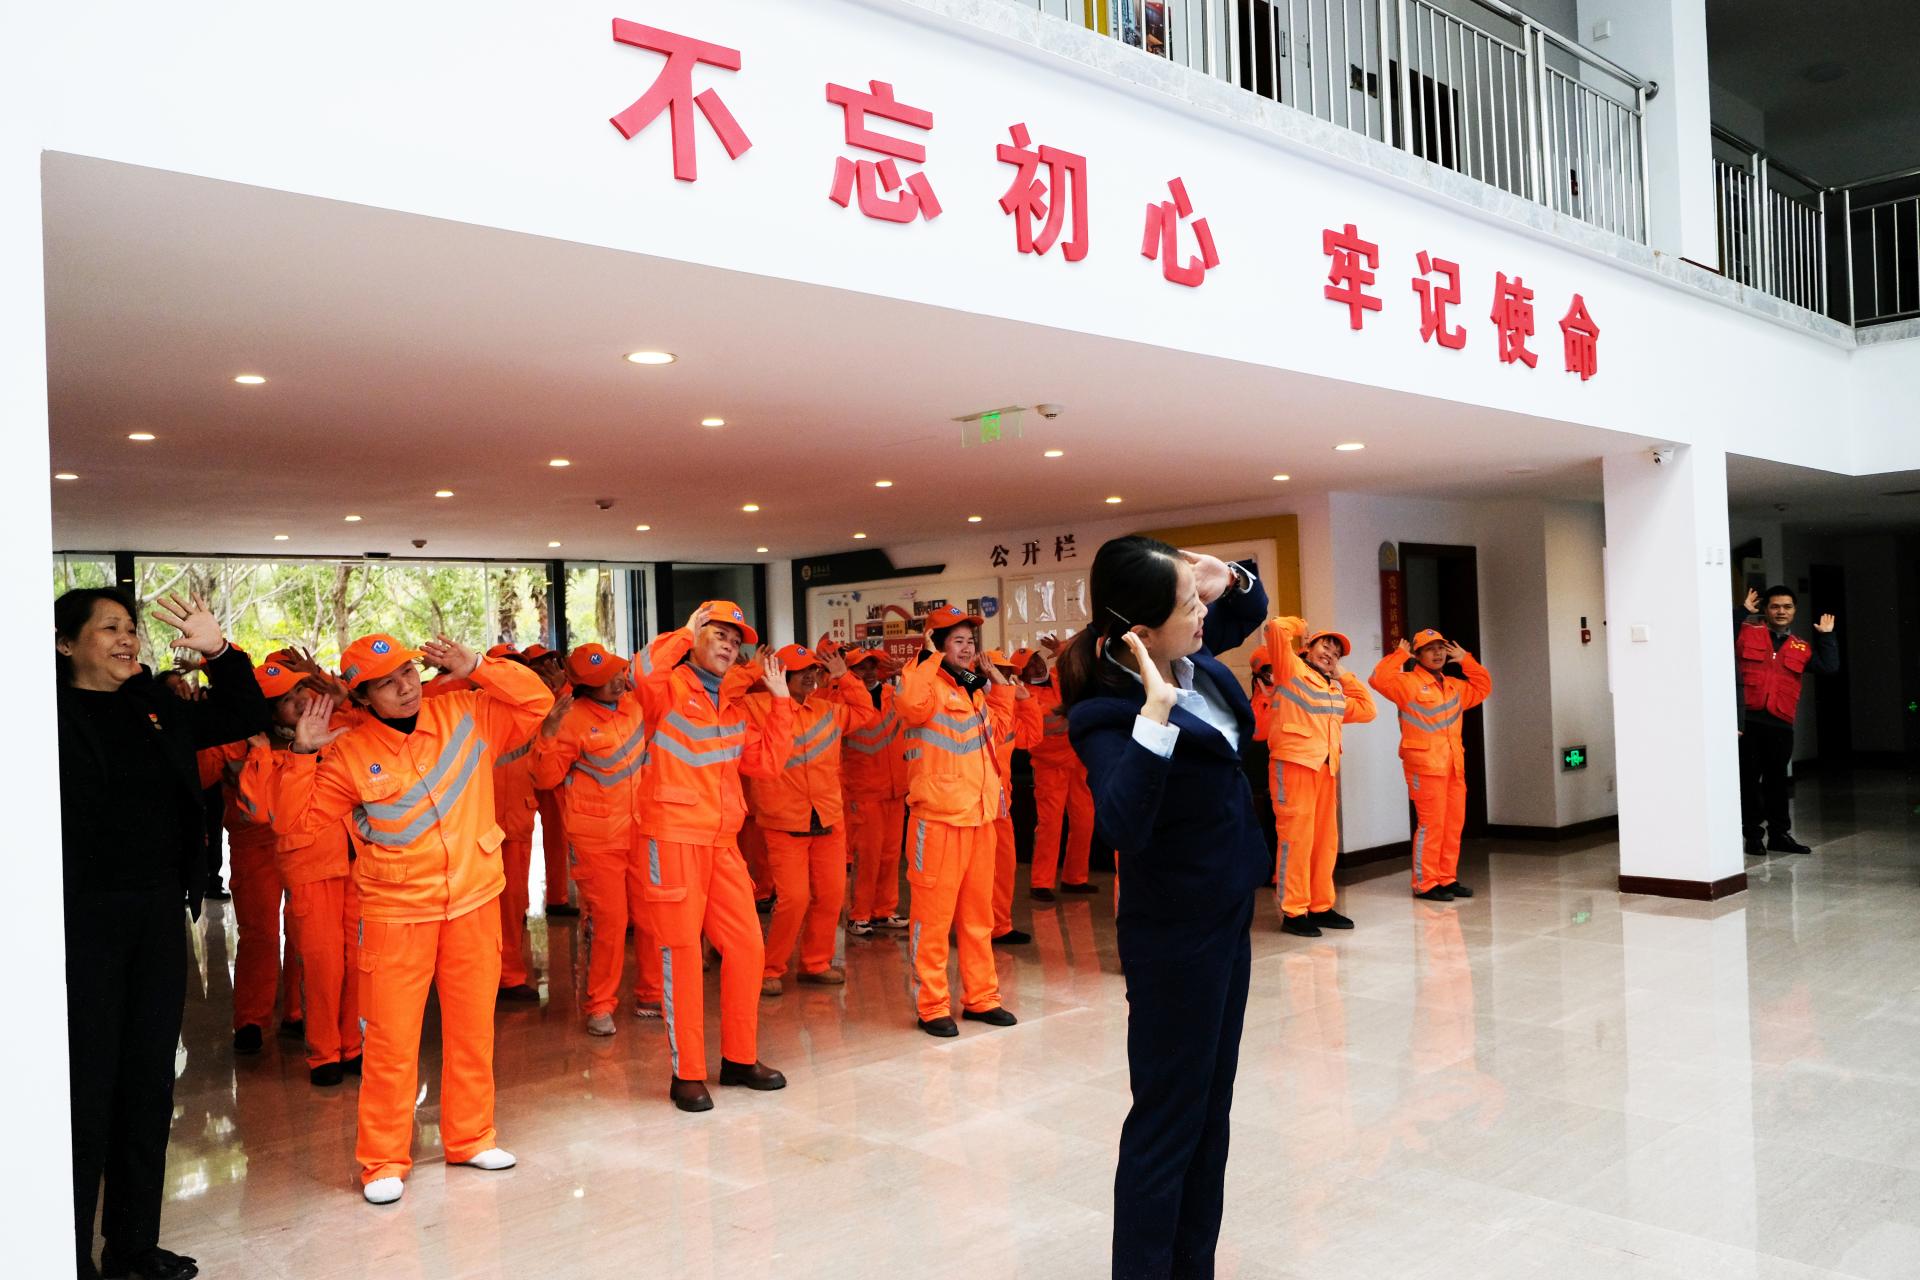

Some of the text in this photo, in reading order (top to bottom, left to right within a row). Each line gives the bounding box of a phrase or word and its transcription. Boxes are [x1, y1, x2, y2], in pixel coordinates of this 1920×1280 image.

[610, 18, 1600, 381] 不忘初心 牢记使命
[990, 534, 1077, 568] 公开栏
